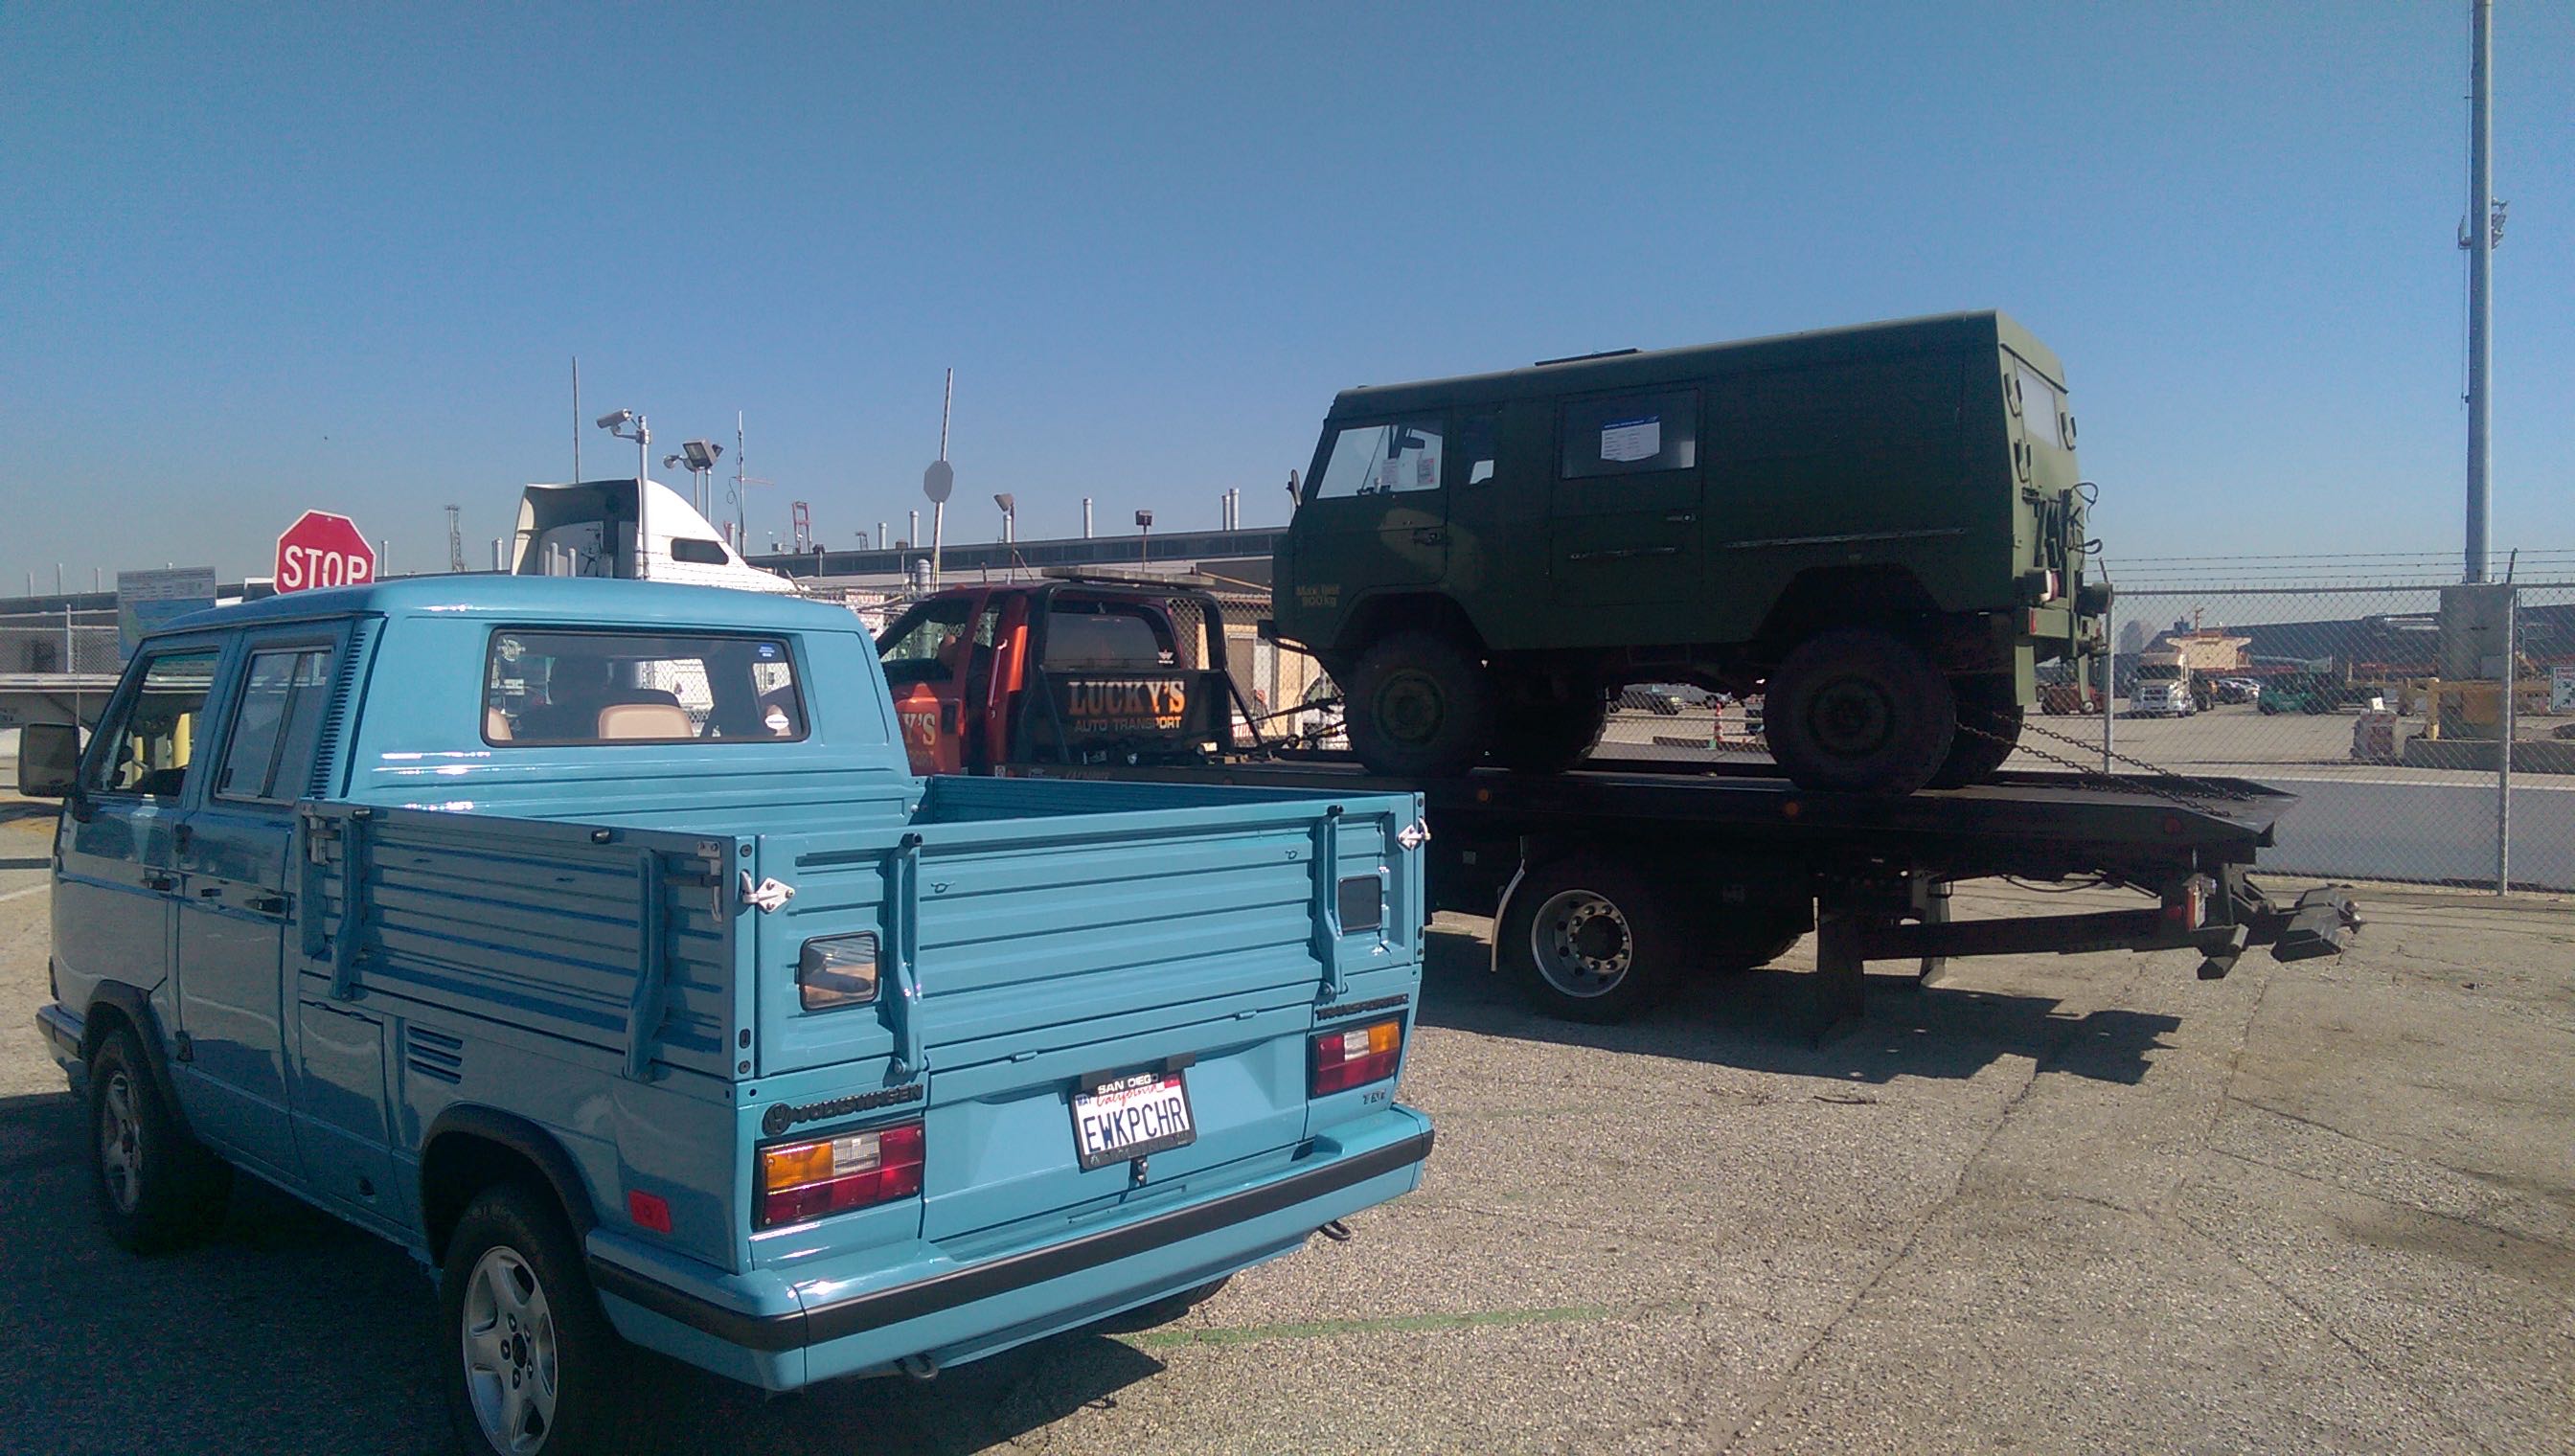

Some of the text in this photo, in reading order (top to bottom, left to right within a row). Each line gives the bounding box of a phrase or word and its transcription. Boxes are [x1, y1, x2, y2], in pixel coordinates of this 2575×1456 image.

[283, 544, 368, 589] STOP
[1067, 679, 1186, 716] LUCKY'S
[1074, 716, 1181, 732] AUTO TRANSPORT
[1097, 1080, 1125, 1095] SAN
[1128, 1073, 1159, 1088] DIEGO
[1083, 1097, 1186, 1152] EWKPCHR
